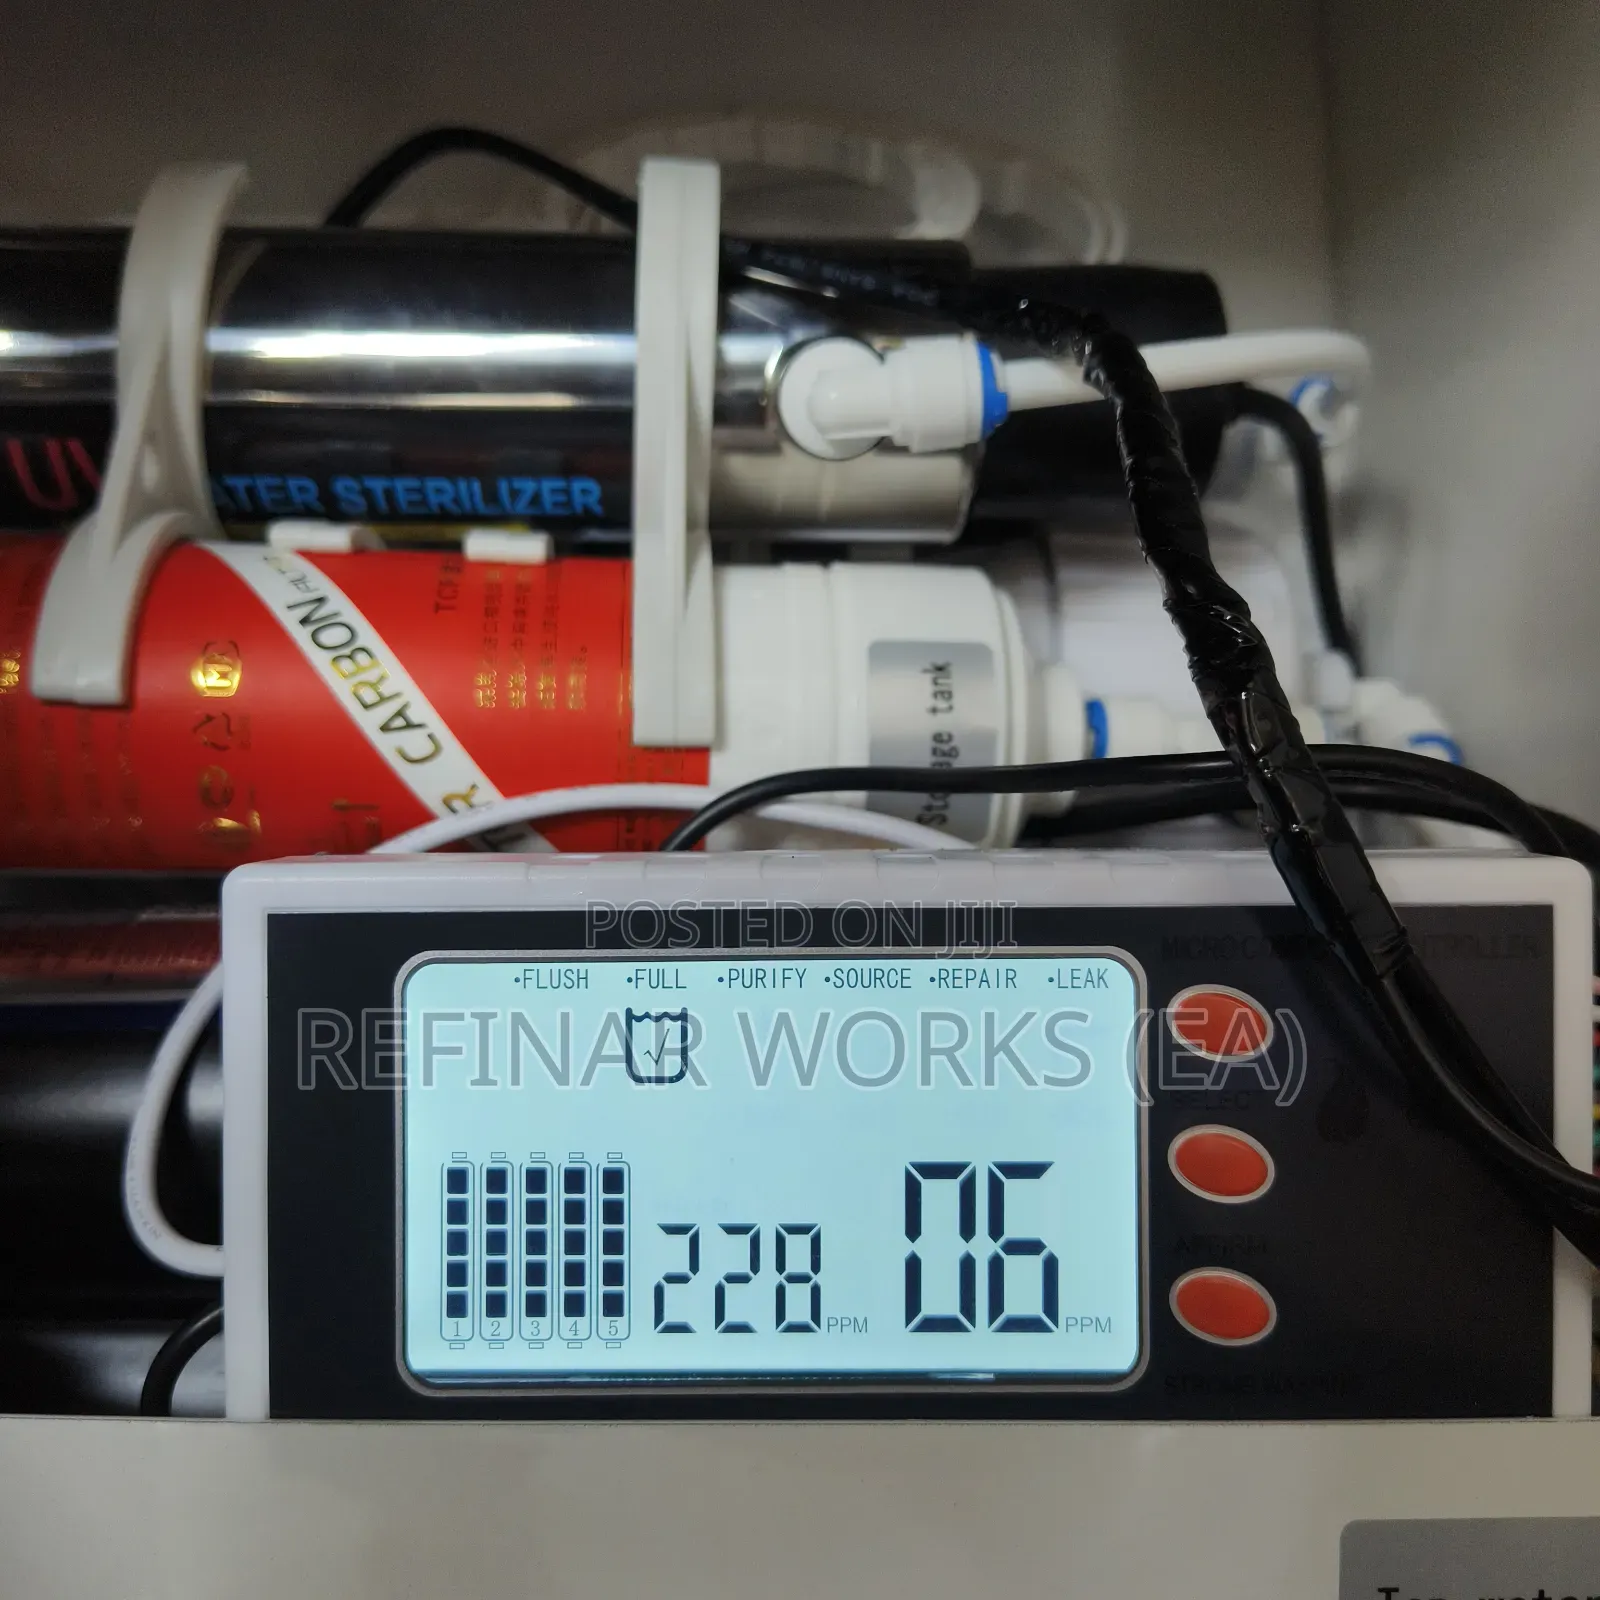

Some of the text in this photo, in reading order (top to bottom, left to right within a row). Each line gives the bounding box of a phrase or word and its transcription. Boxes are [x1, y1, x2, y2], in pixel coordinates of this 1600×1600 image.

[329, 475, 604, 515] STERILIZER
[286, 595, 444, 765] CARBON
[921, 661, 955, 716] tank
[522, 967, 589, 990] FLUSH
[634, 967, 687, 990] FULL
[727, 967, 807, 990] PURIFY
[832, 967, 912, 990] SOURCE
[937, 967, 1018, 990] REPAIR
[1056, 967, 1110, 990] LEAK
[904, 1160, 1113, 1334] 06 PPM
[653, 1222, 869, 1334] 228 PPM
[452, 1320, 619, 1337] 1 2 3 4 5
